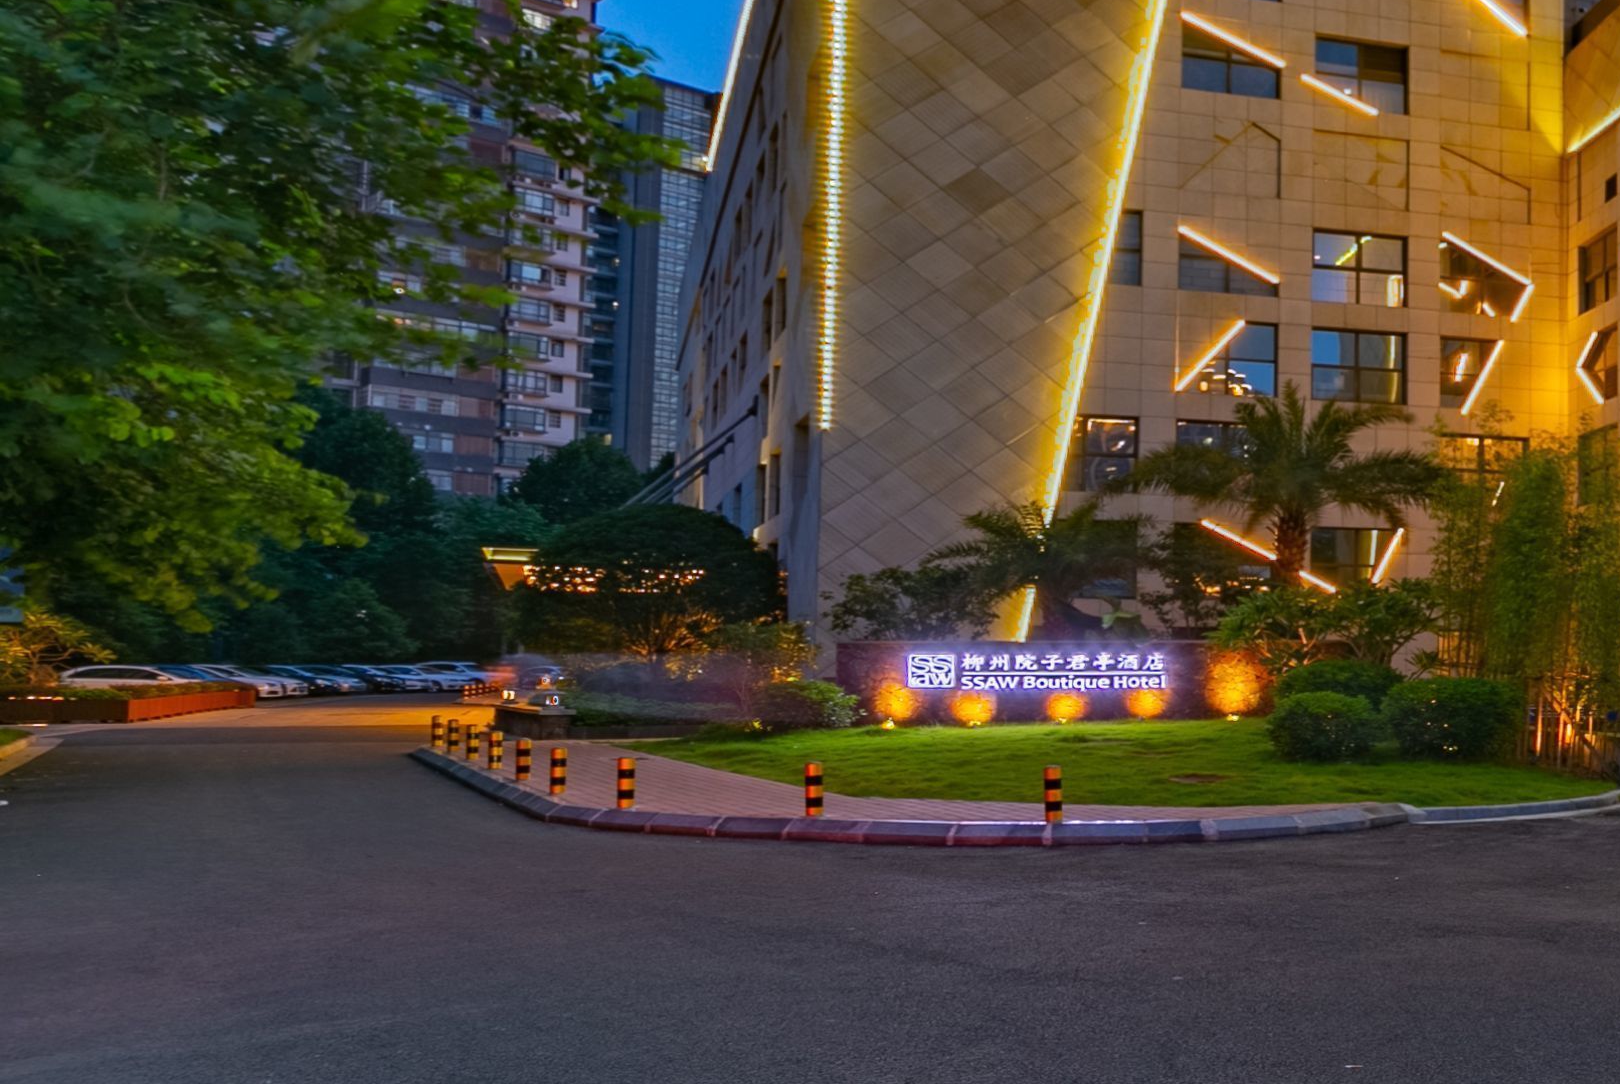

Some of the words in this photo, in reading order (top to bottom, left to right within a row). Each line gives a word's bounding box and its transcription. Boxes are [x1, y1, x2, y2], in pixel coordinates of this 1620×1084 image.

[961, 653, 1164, 671] 柳州院子君亭酒店
[961, 676, 1019, 689] SSAW
[1023, 675, 1111, 691] Boutique
[1113, 675, 1166, 689] Hotel
